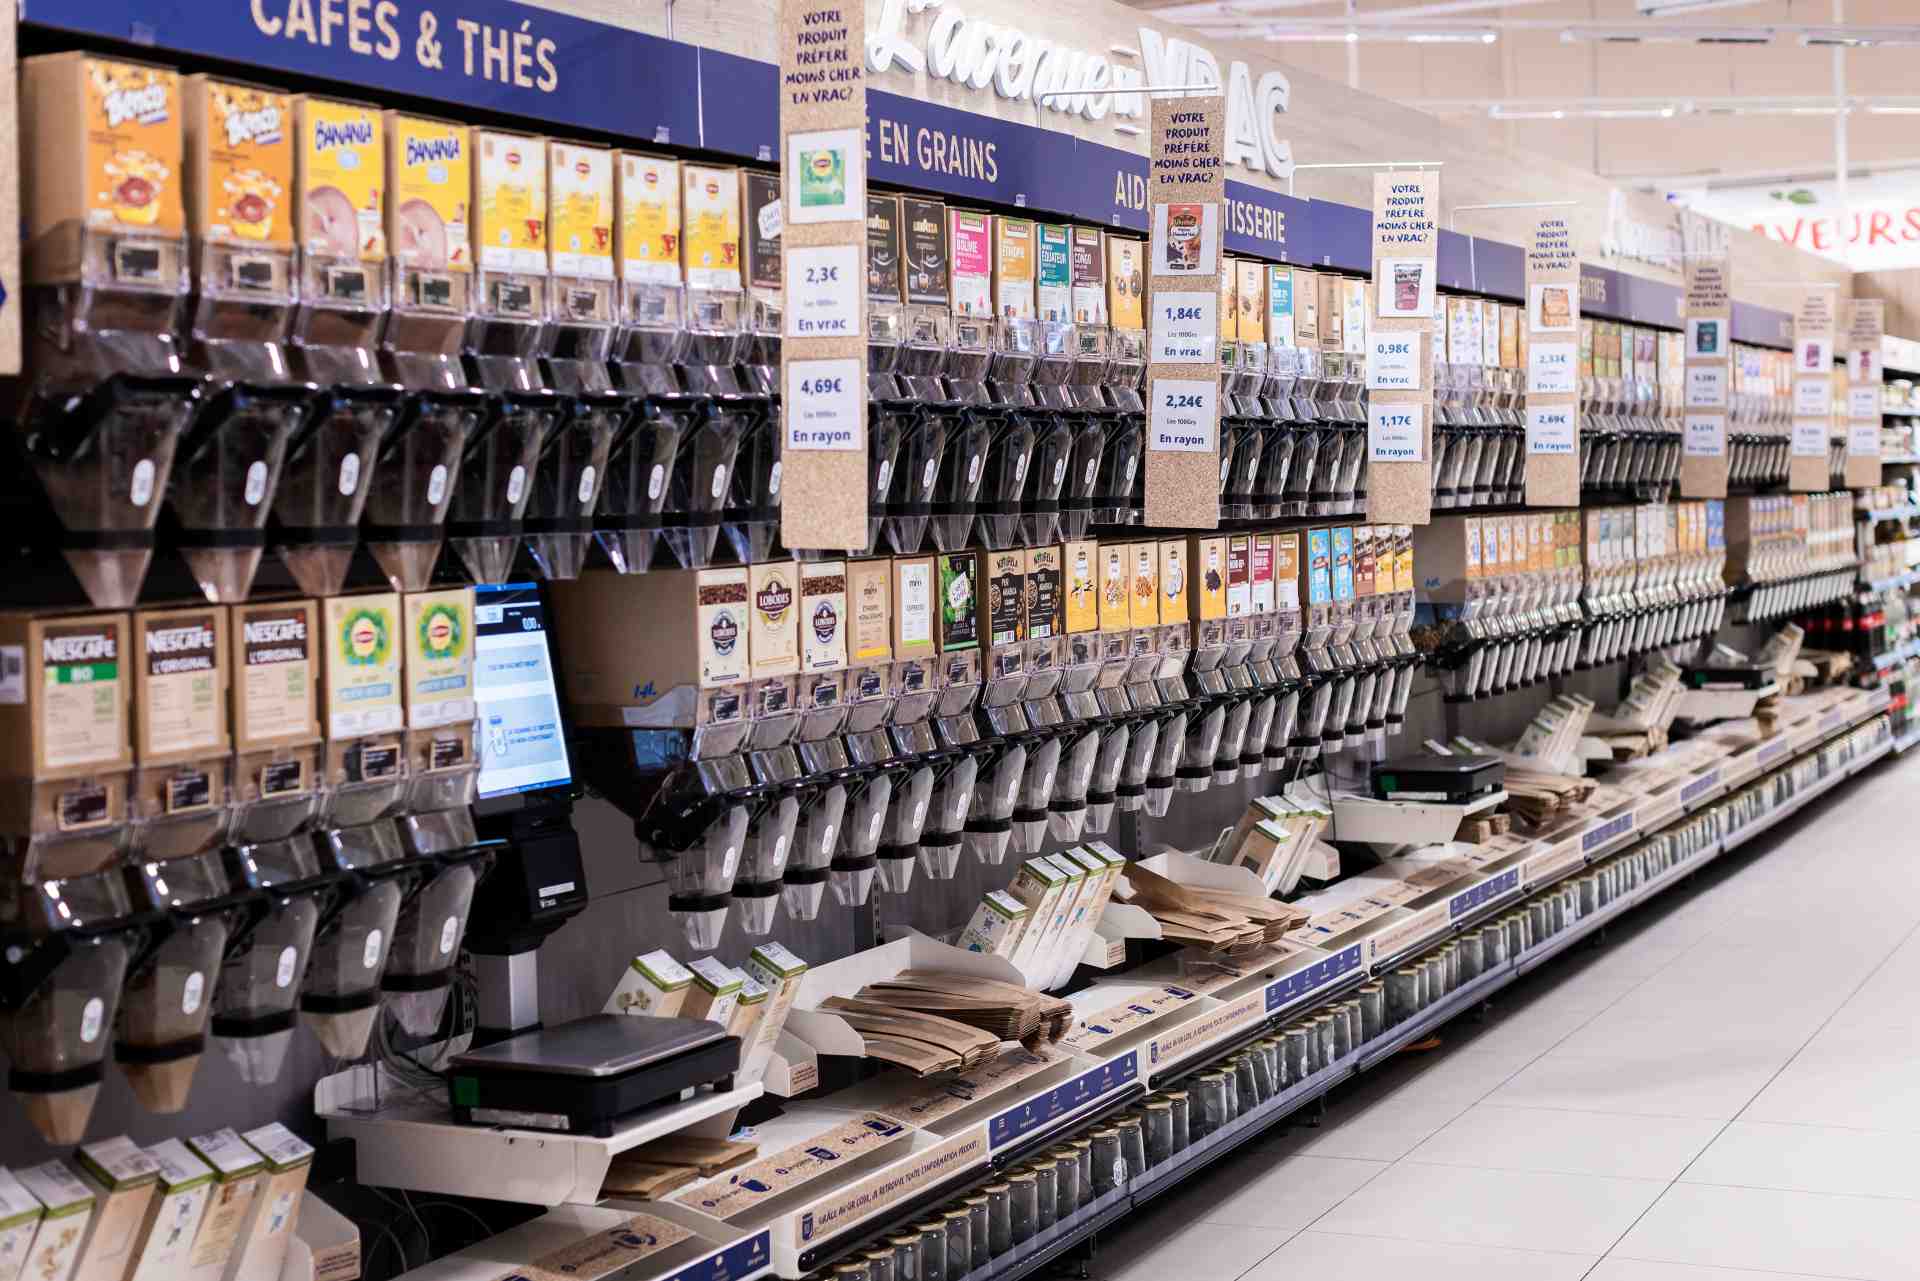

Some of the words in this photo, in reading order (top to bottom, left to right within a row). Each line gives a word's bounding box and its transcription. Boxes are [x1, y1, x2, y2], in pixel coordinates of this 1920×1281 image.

[803, 10, 842, 25] VOTRE
[797, 28, 848, 45] PRODUIT
[416, 9, 443, 70] &
[457, 19, 558, 93] THÉS
[785, 70, 826, 85] MOINS
[829, 66, 861, 82] CHER
[792, 91, 809, 105] EN
[812, 87, 853, 103] VRAC?
[1171, 112, 1205, 124] VOTRE
[1166, 127, 1210, 139] PRODUIT
[879, 119, 909, 166] EN
[917, 127, 998, 183] GRAINS
[1154, 157, 1190, 169] MOINS
[1192, 155, 1220, 168] CHER
[1160, 173, 1174, 184] EN
[1178, 172, 1214, 183] VRAC?
[1391, 184, 1420, 194] VOTRE
[1387, 196, 1424, 206] PRODUIT
[1376, 222, 1407, 231] MOINS
[1409, 221, 1435, 231] CHER
[1382, 234, 1394, 243] EN
[1397, 233, 1428, 243] VRAC?
[806, 266, 839, 284] 2,3€
[1165, 307, 1203, 322] 1,84€
[798, 319, 814, 331] En
[816, 318, 847, 331] vrac
[1164, 346, 1176, 357] En
[1179, 347, 1202, 357] vrac
[1377, 343, 1409, 356] 0,98€
[1377, 375, 1388, 384] En
[1389, 376, 1409, 384] vrac
[801, 378, 842, 396] 4,69€
[1165, 395, 1203, 409] 2,24€
[1379, 415, 1412, 427] 1,17€
[793, 430, 809, 442] En
[812, 430, 851, 446] rayon
[1159, 434, 1171, 444] En
[1174, 435, 1205, 447] rayon
[1376, 447, 1387, 456] En
[1388, 448, 1414, 458] rayon
